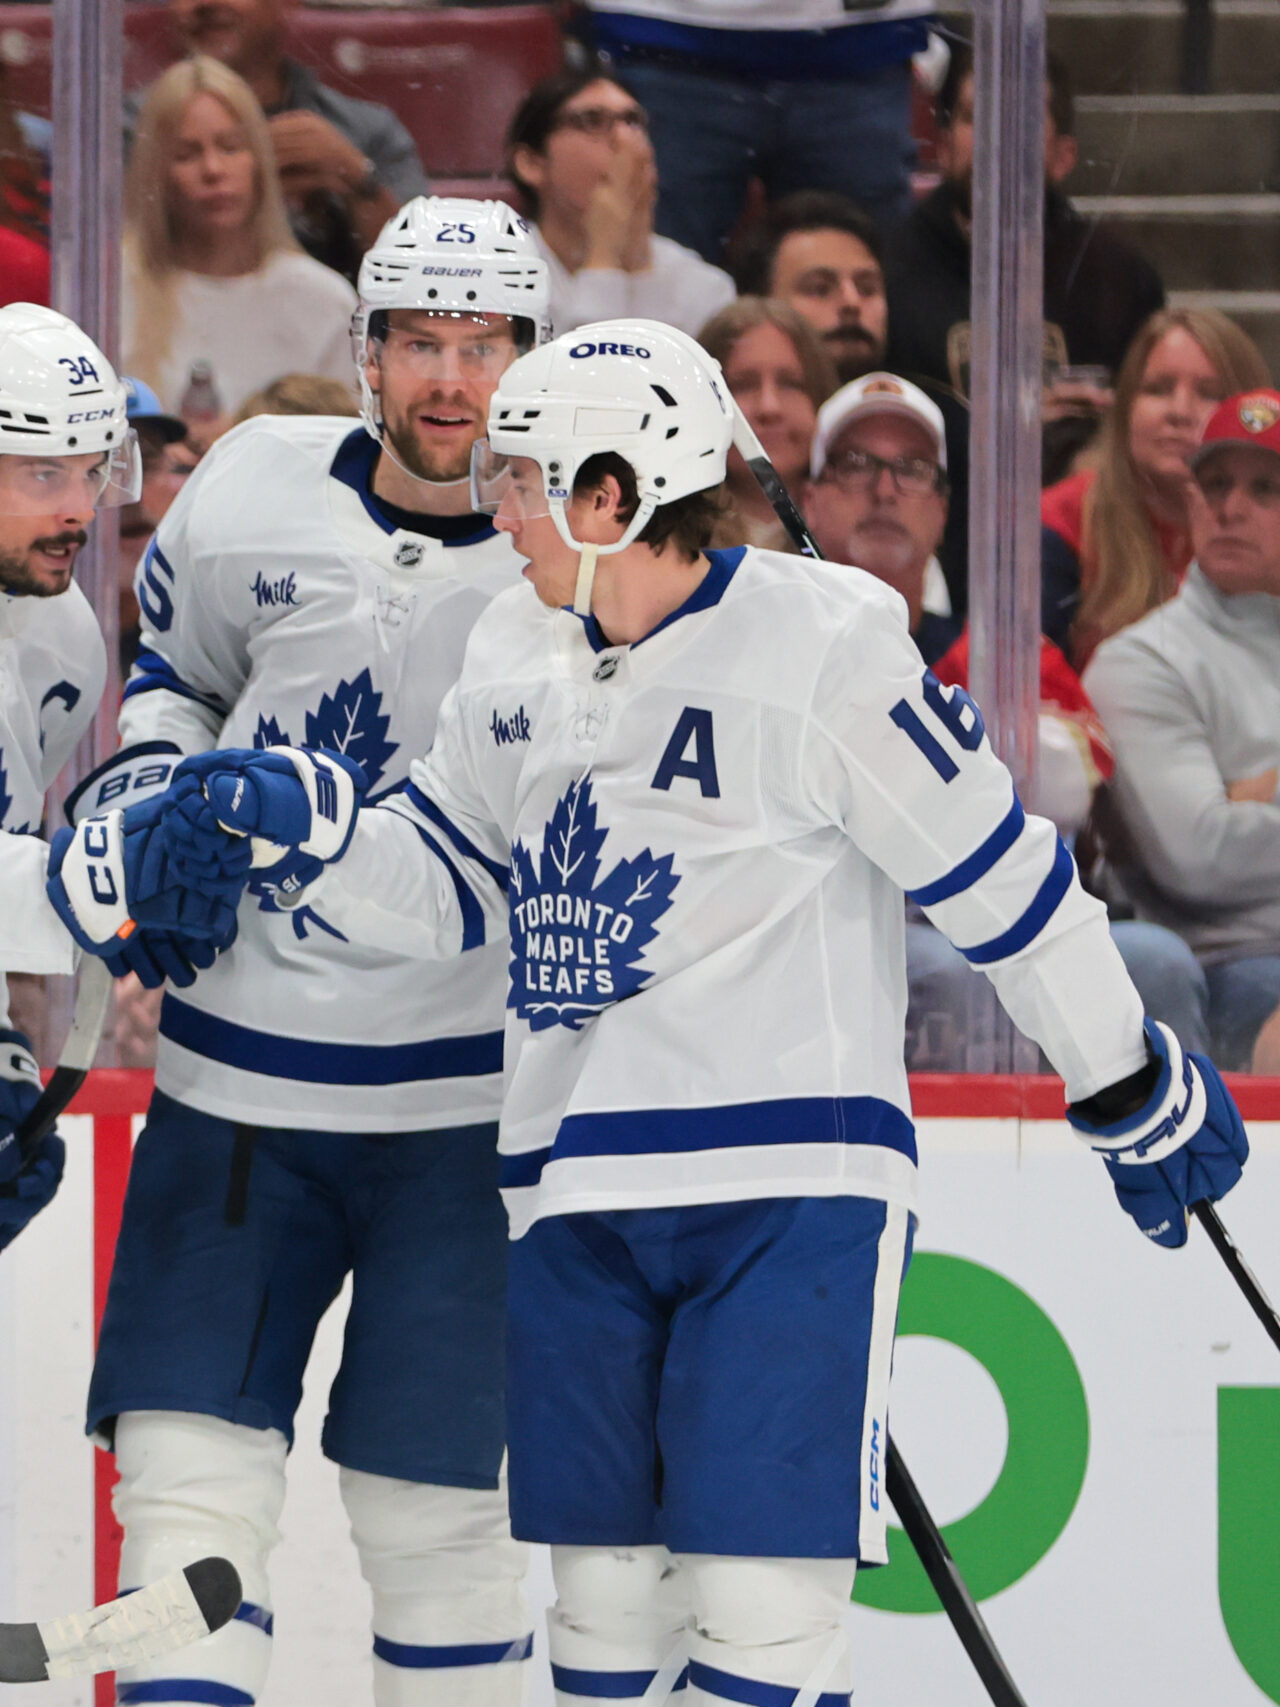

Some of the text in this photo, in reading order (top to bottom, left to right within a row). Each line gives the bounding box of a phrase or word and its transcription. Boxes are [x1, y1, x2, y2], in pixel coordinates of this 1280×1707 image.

[435, 222, 476, 244] 25
[569, 342, 651, 360] OREO
[58, 356, 99, 386] 34
[66, 407, 115, 425] CCM
[249, 570, 302, 608] Milk
[490, 705, 532, 747] Milk
[887, 666, 985, 785] 16
[650, 706, 721, 799] A
[514, 893, 634, 944] TORONTO
[526, 931, 610, 966] MAPLE
[526, 963, 615, 995] LEAFS
[869, 1416, 879, 1512] CCM
